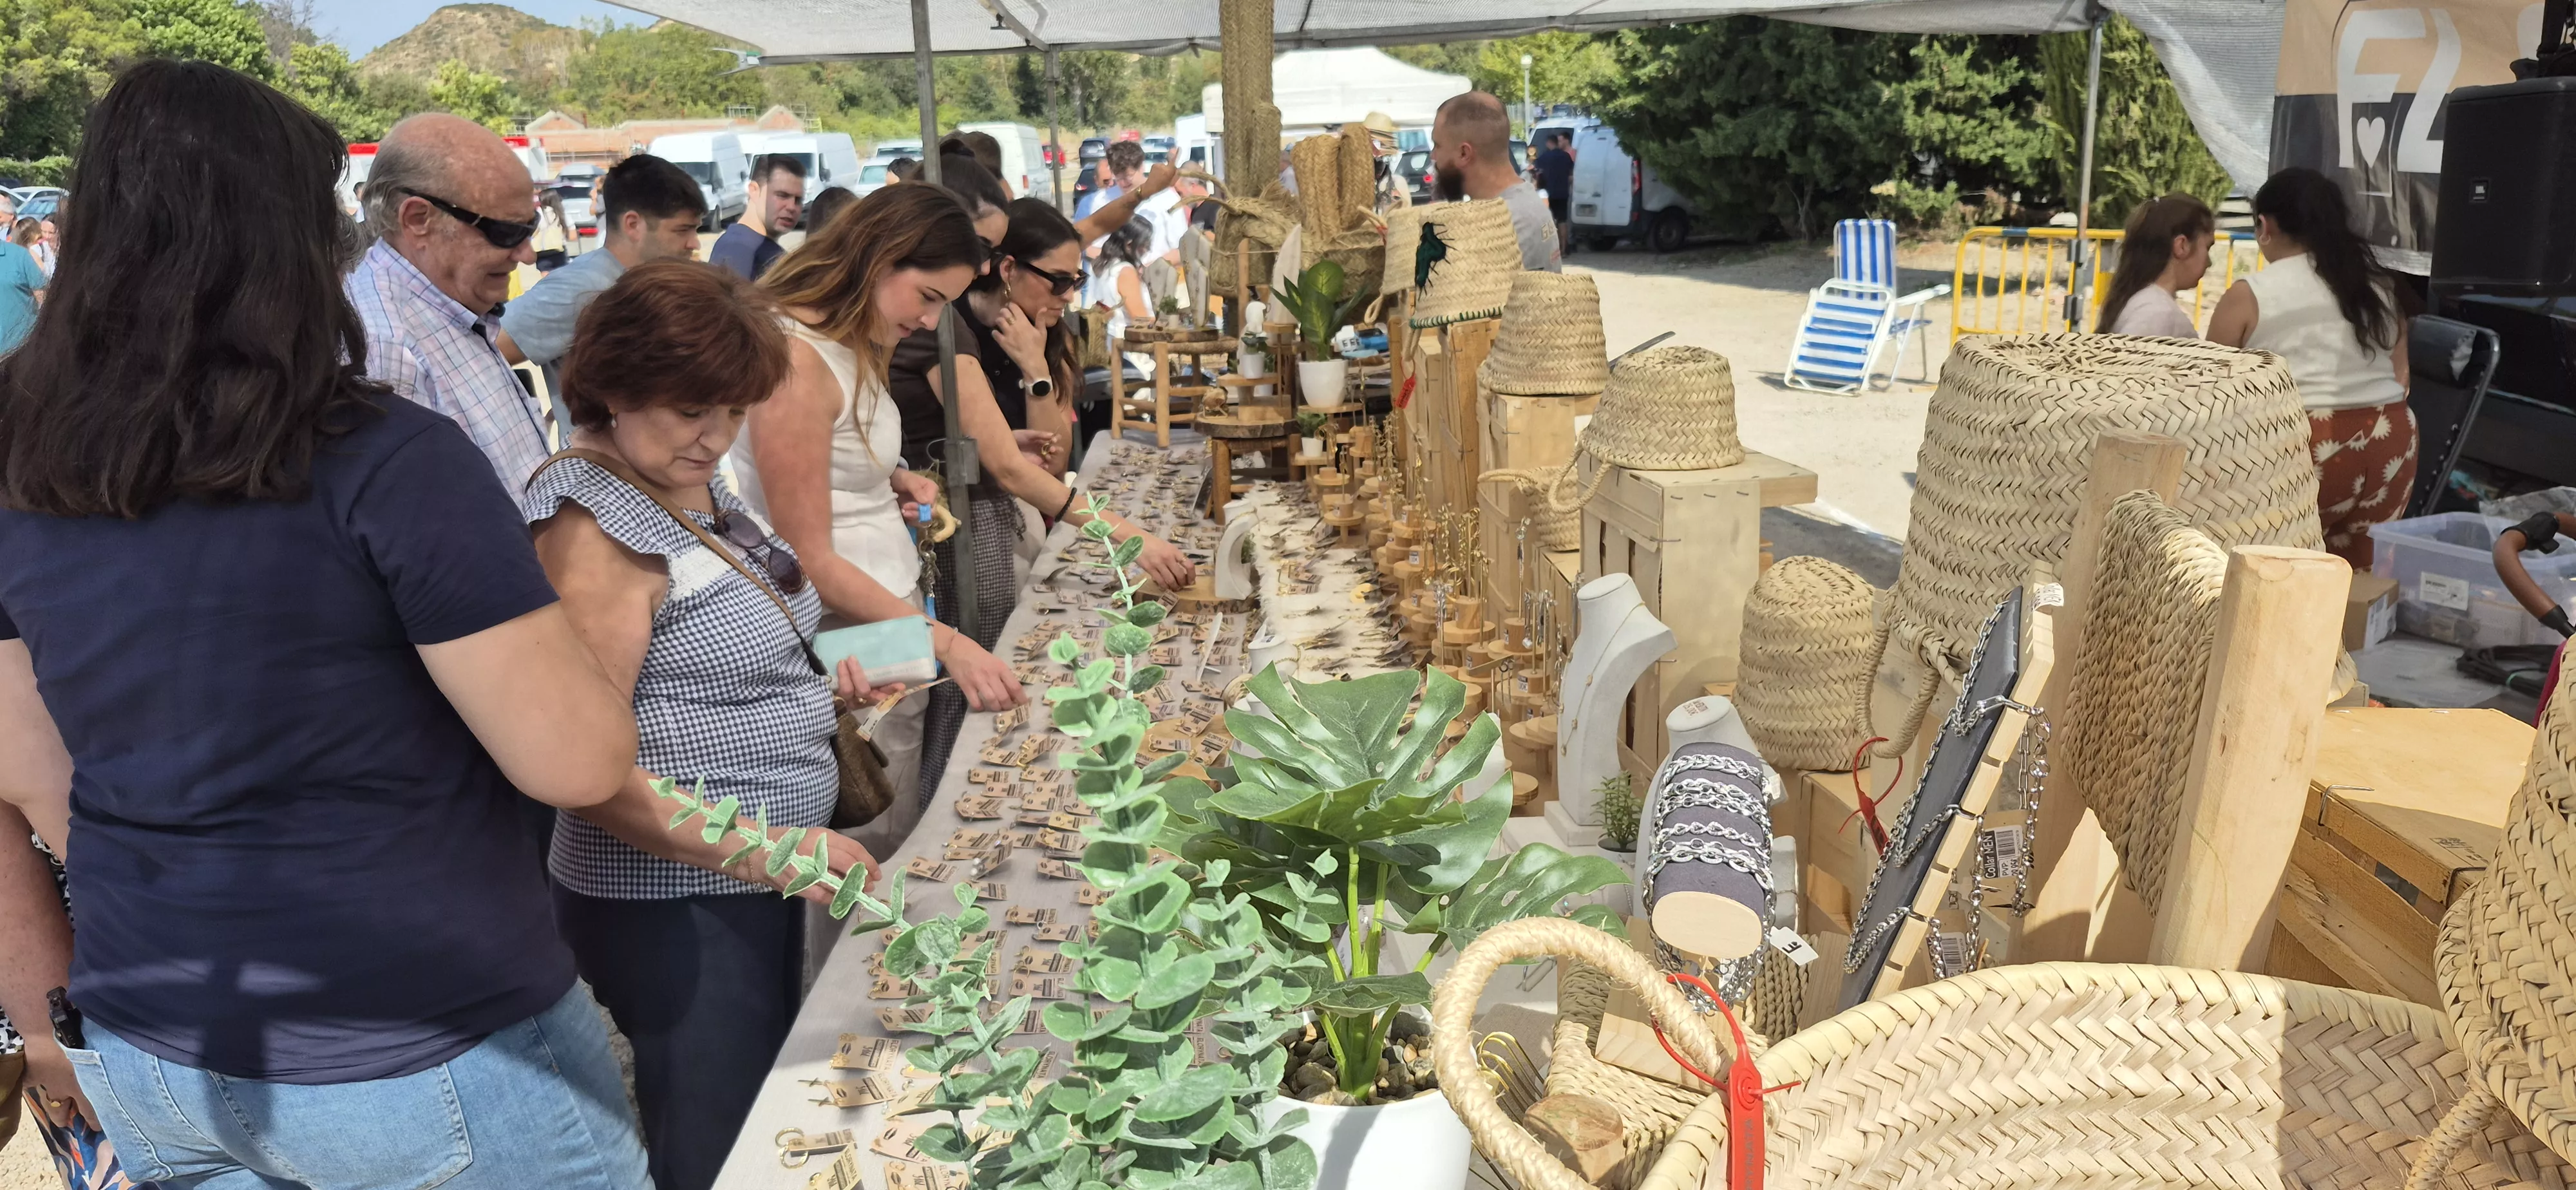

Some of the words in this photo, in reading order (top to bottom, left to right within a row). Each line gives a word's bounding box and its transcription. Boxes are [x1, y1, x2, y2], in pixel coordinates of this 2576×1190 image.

[1983, 835, 1994, 855] MEN
[1985, 856, 1996, 878] Collar
[1745, 1119, 1755, 1190] RYNATA
